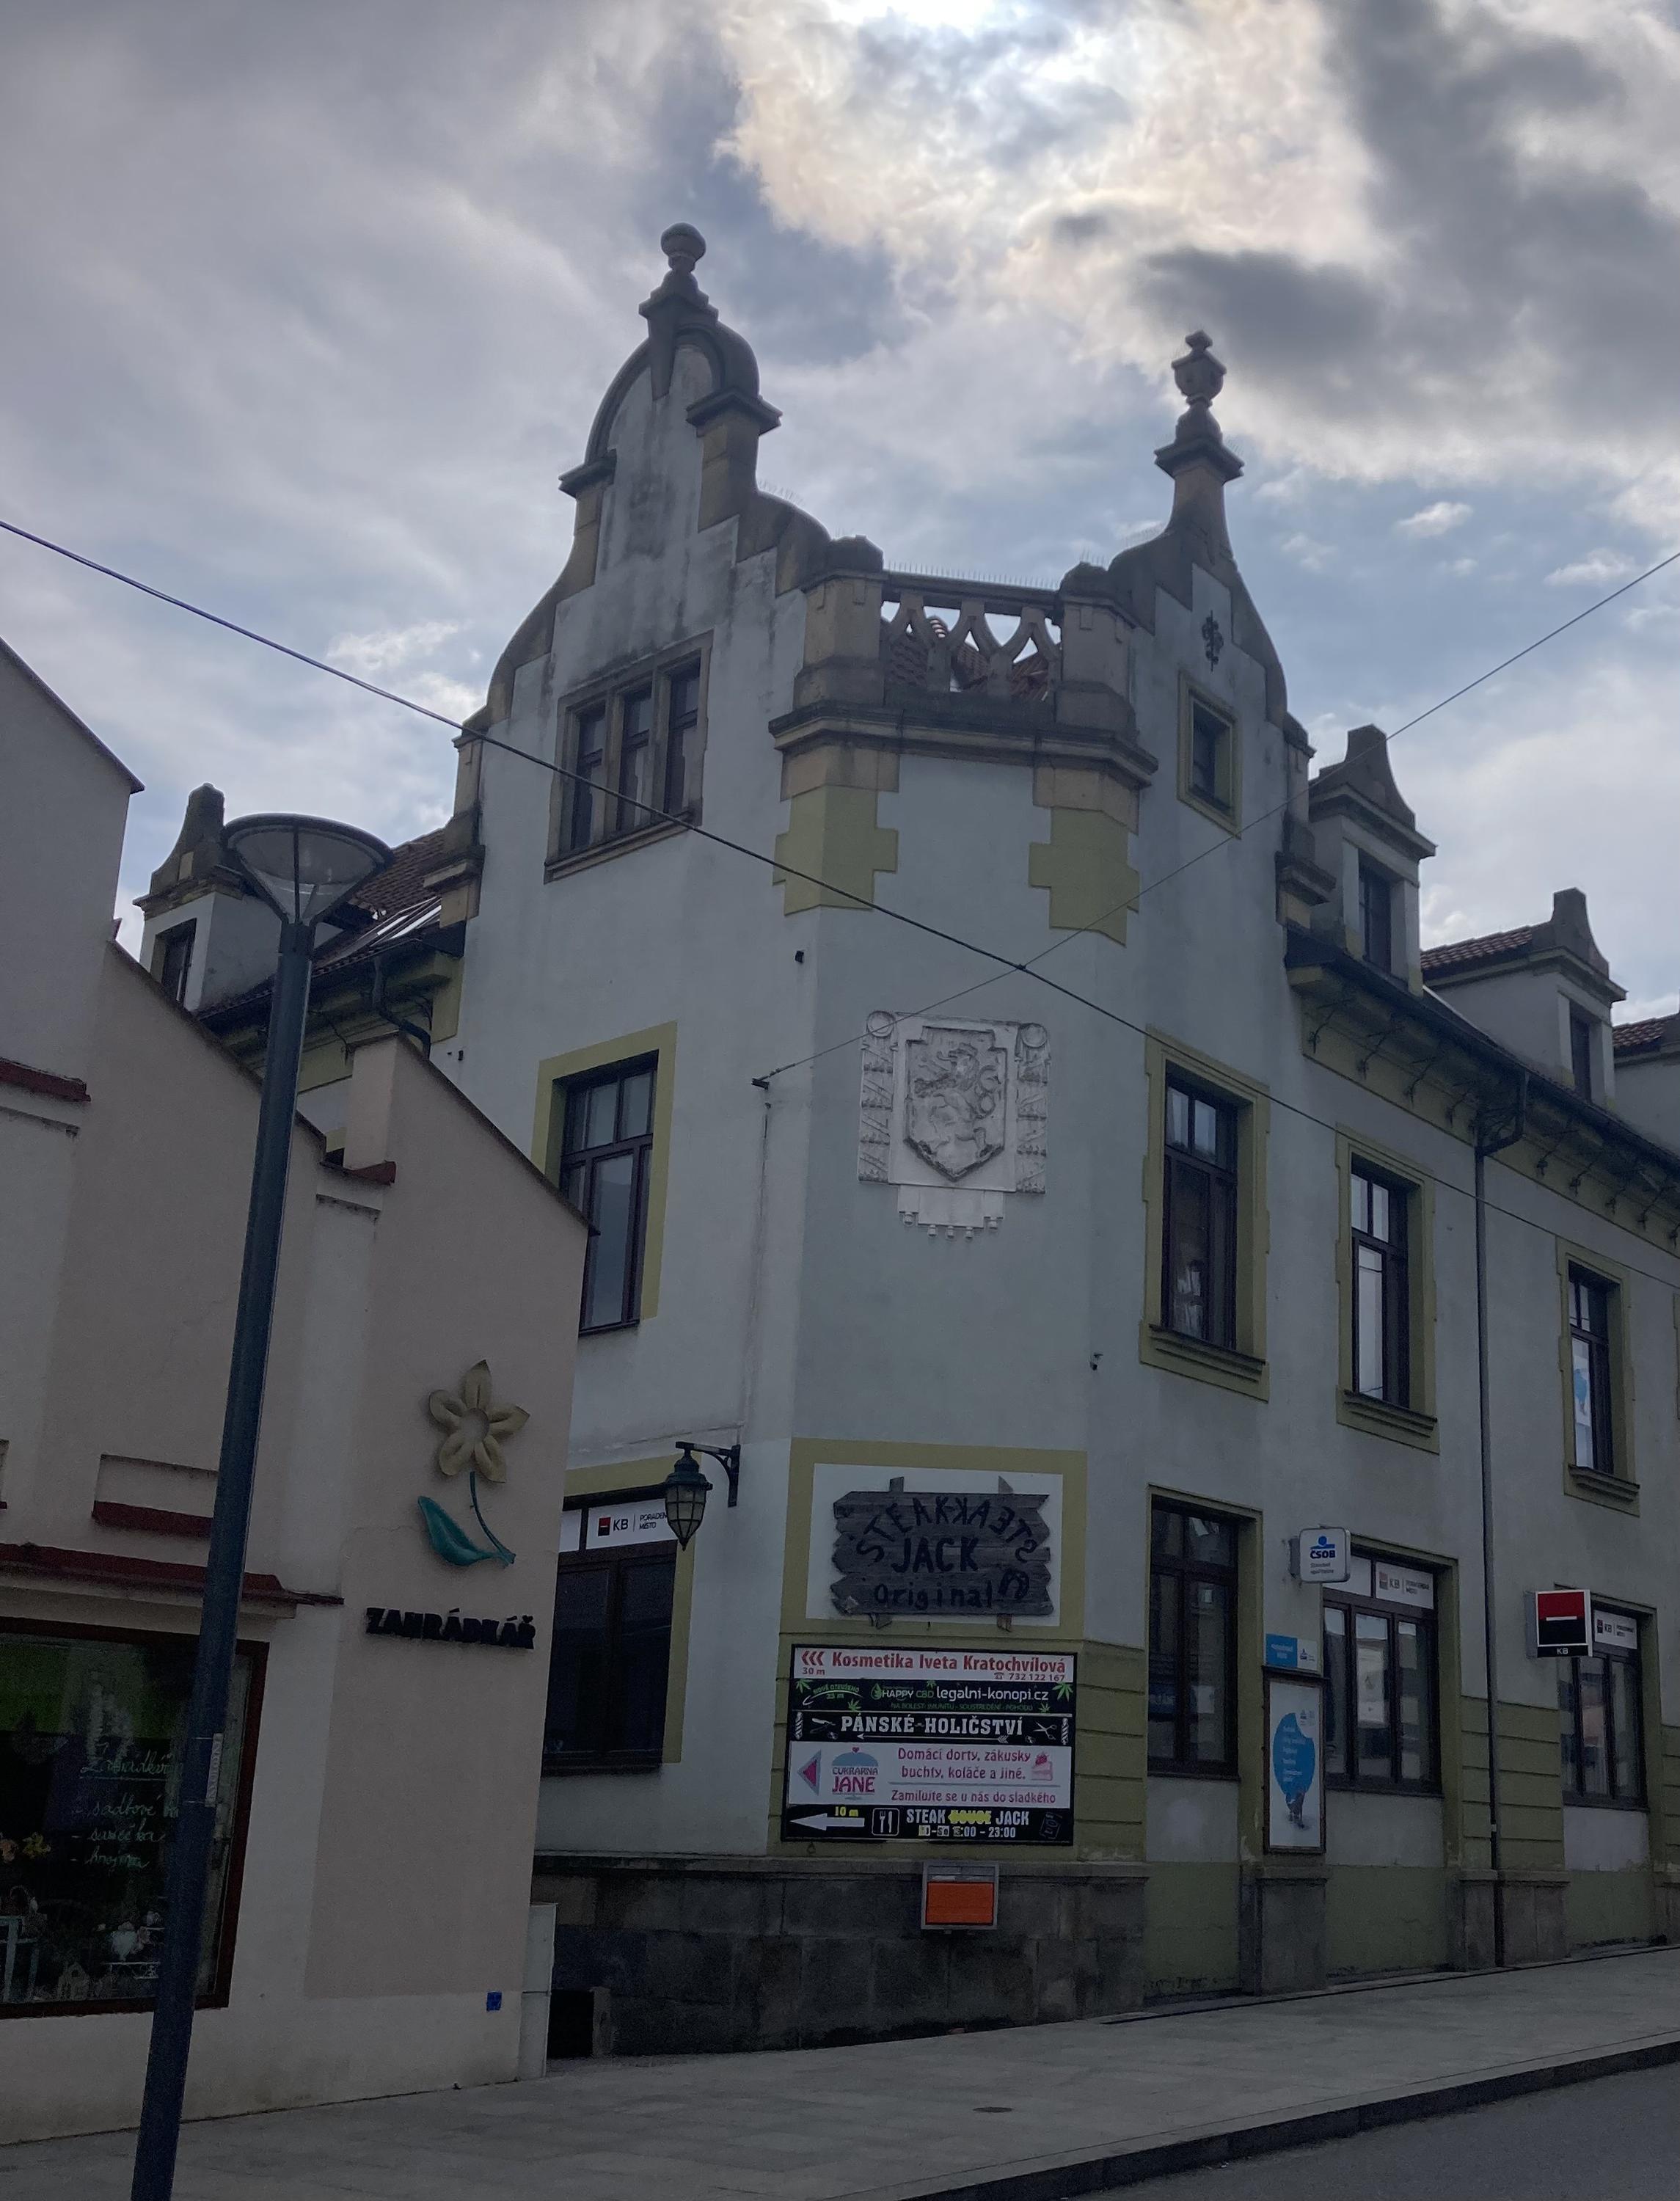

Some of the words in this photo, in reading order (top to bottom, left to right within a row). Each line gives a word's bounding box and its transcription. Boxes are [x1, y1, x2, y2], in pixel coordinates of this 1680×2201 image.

[613, 1519, 629, 1532] KB
[855, 1496, 954, 1567] STEAK
[891, 1537, 979, 1573] JACK
[874, 1580, 993, 1610] Original
[832, 1651, 913, 1668] Kosmetika
[919, 1654, 957, 1670] Iveta
[963, 1655, 1065, 1673] Kratochvílová
[802, 1667, 814, 1675] 30
[882, 1689, 914, 1698] HAPPY
[841, 1713, 915, 1732] PÁNSKÉ
[924, 1715, 1023, 1735] HOLIČSTVÍ
[898, 1748, 942, 1760] Domácí
[985, 1749, 1031, 1762] zákusky
[948, 1766, 985, 1778] koláče
[990, 1770, 996, 1779] a
[832, 1776, 876, 1793] JANE
[891, 1789, 942, 1801] Zamilujte
[946, 1792, 957, 1801] se
[961, 1793, 967, 1801] u
[971, 1791, 989, 1802] nás
[993, 1792, 1006, 1802] do
[1009, 1791, 1056, 1803] sladkého
[834, 1806, 847, 1817] 10
[906, 1808, 946, 1824] STEAK
[995, 1810, 1029, 1825] JACK
[988, 1826, 1016, 1838] 23:00
